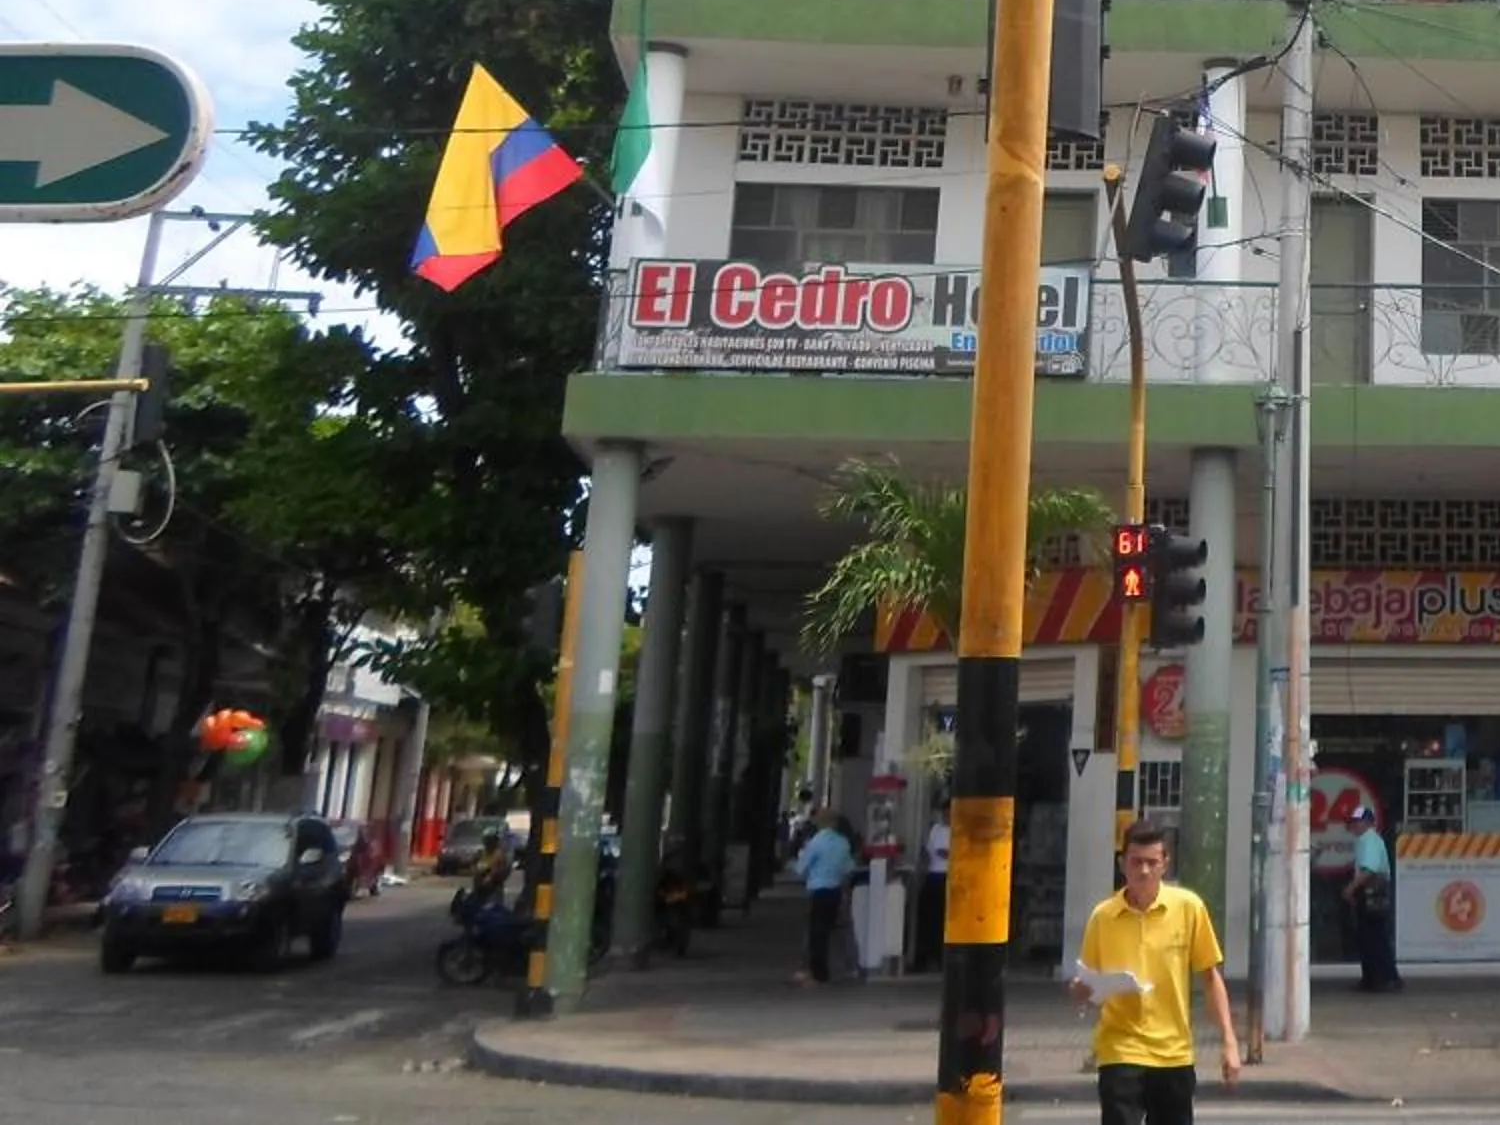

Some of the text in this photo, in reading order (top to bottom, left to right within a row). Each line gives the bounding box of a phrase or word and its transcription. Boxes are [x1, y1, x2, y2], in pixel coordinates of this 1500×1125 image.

[633, 262, 1079, 331] El Cedro Hel
[900, 356, 935, 370] PISCINA
[1119, 532, 1143, 554] 61
[1310, 579, 1407, 629] ebaja
